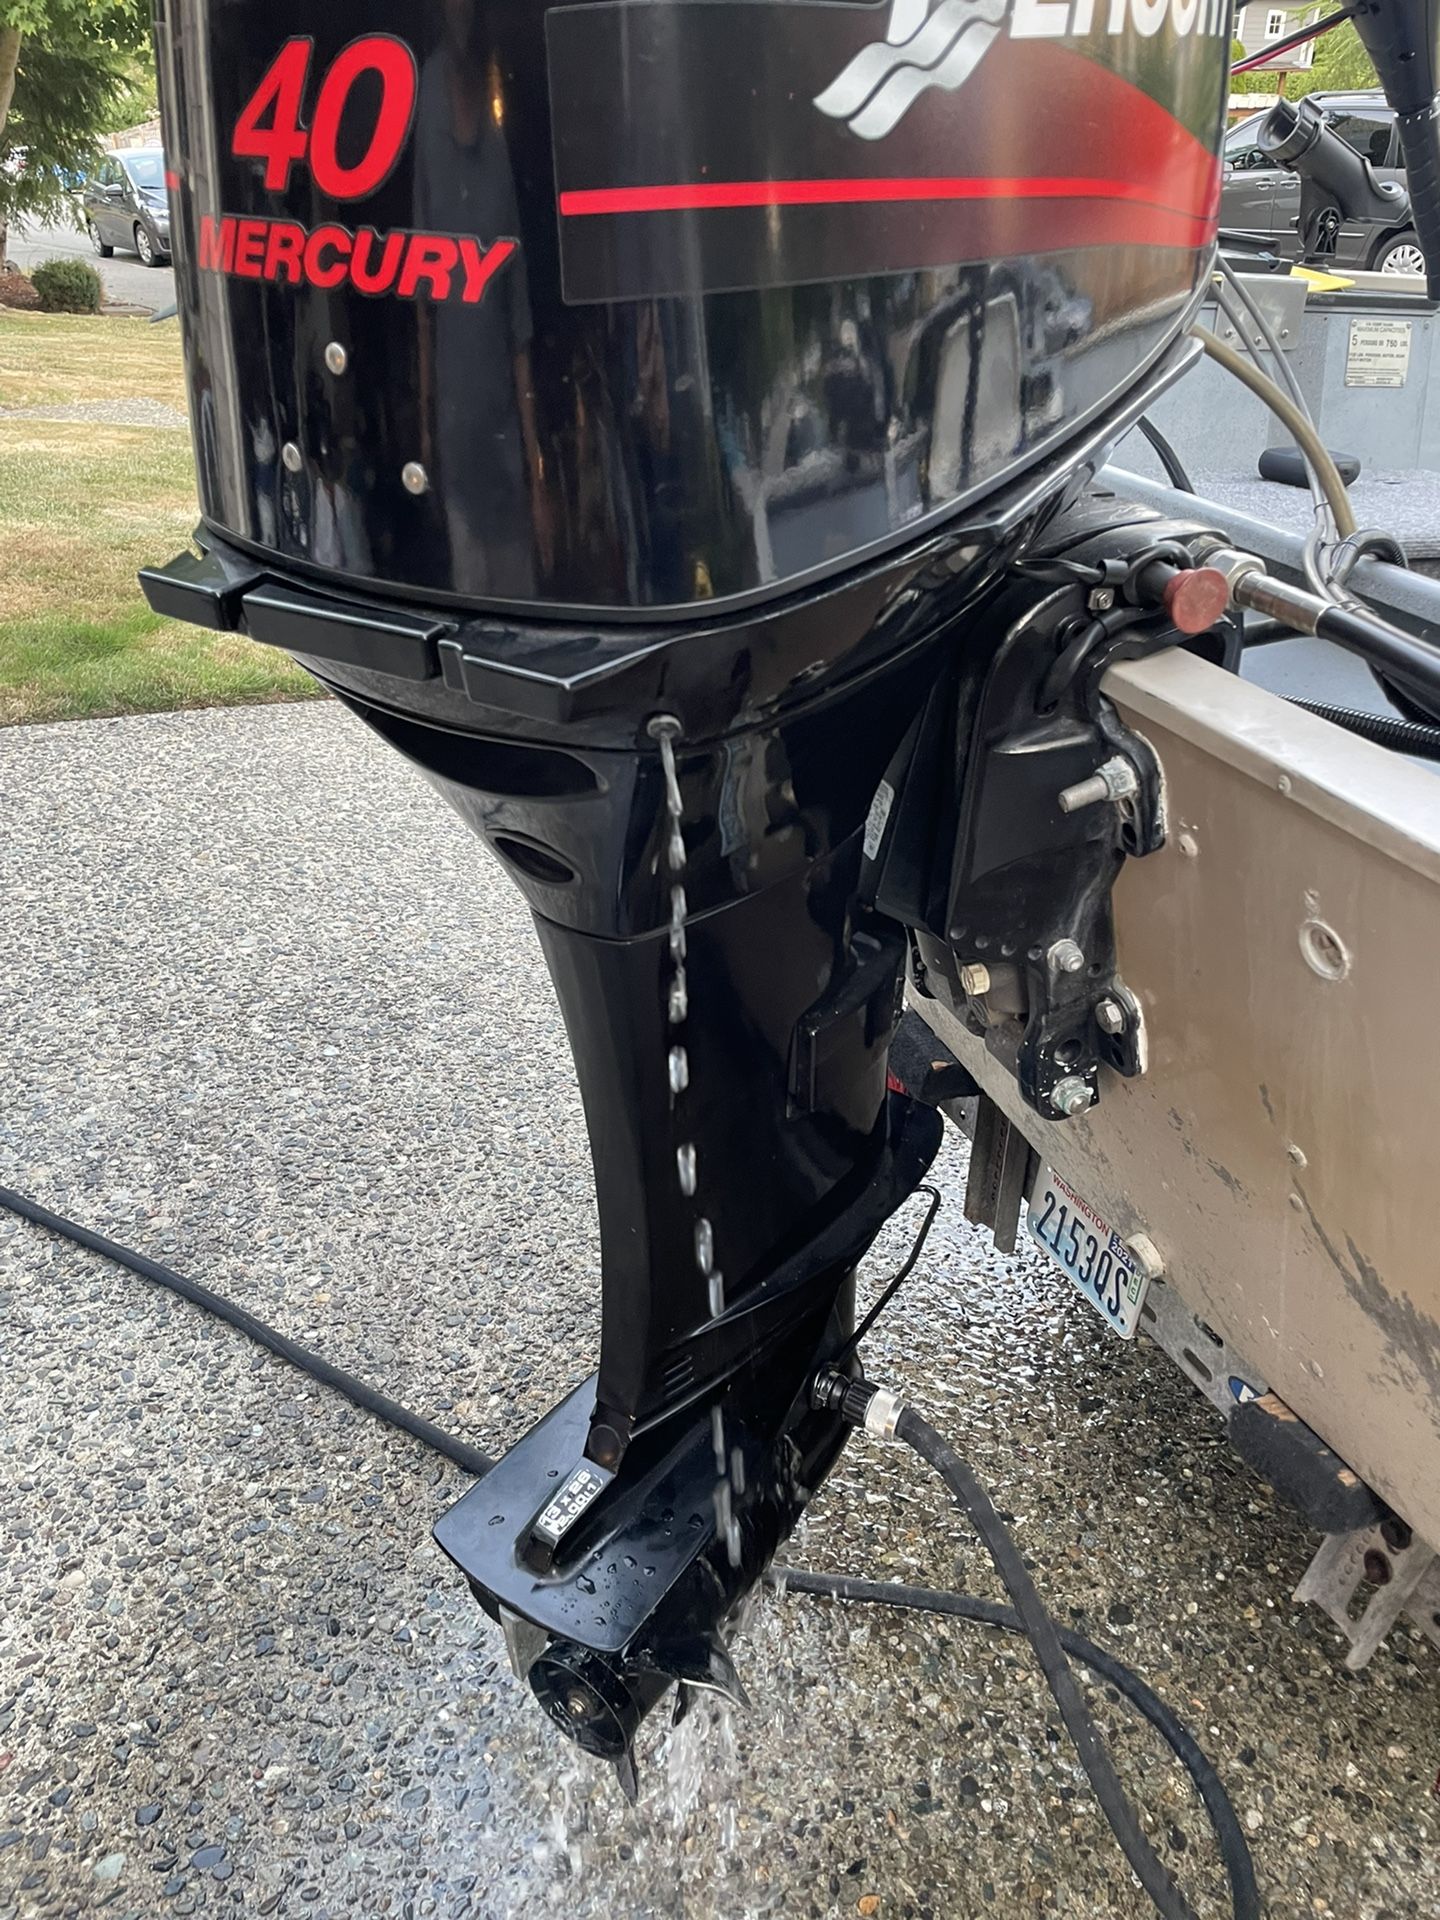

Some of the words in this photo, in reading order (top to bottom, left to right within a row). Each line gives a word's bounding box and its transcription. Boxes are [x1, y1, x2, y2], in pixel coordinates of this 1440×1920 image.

[232, 37, 416, 200] 40
[199, 214, 517, 304] MERCURY
[1351, 334, 1358, 346] 5
[1052, 1173, 1111, 1237] WASHINGTON
[1036, 1190, 1129, 1317] 2153QS
